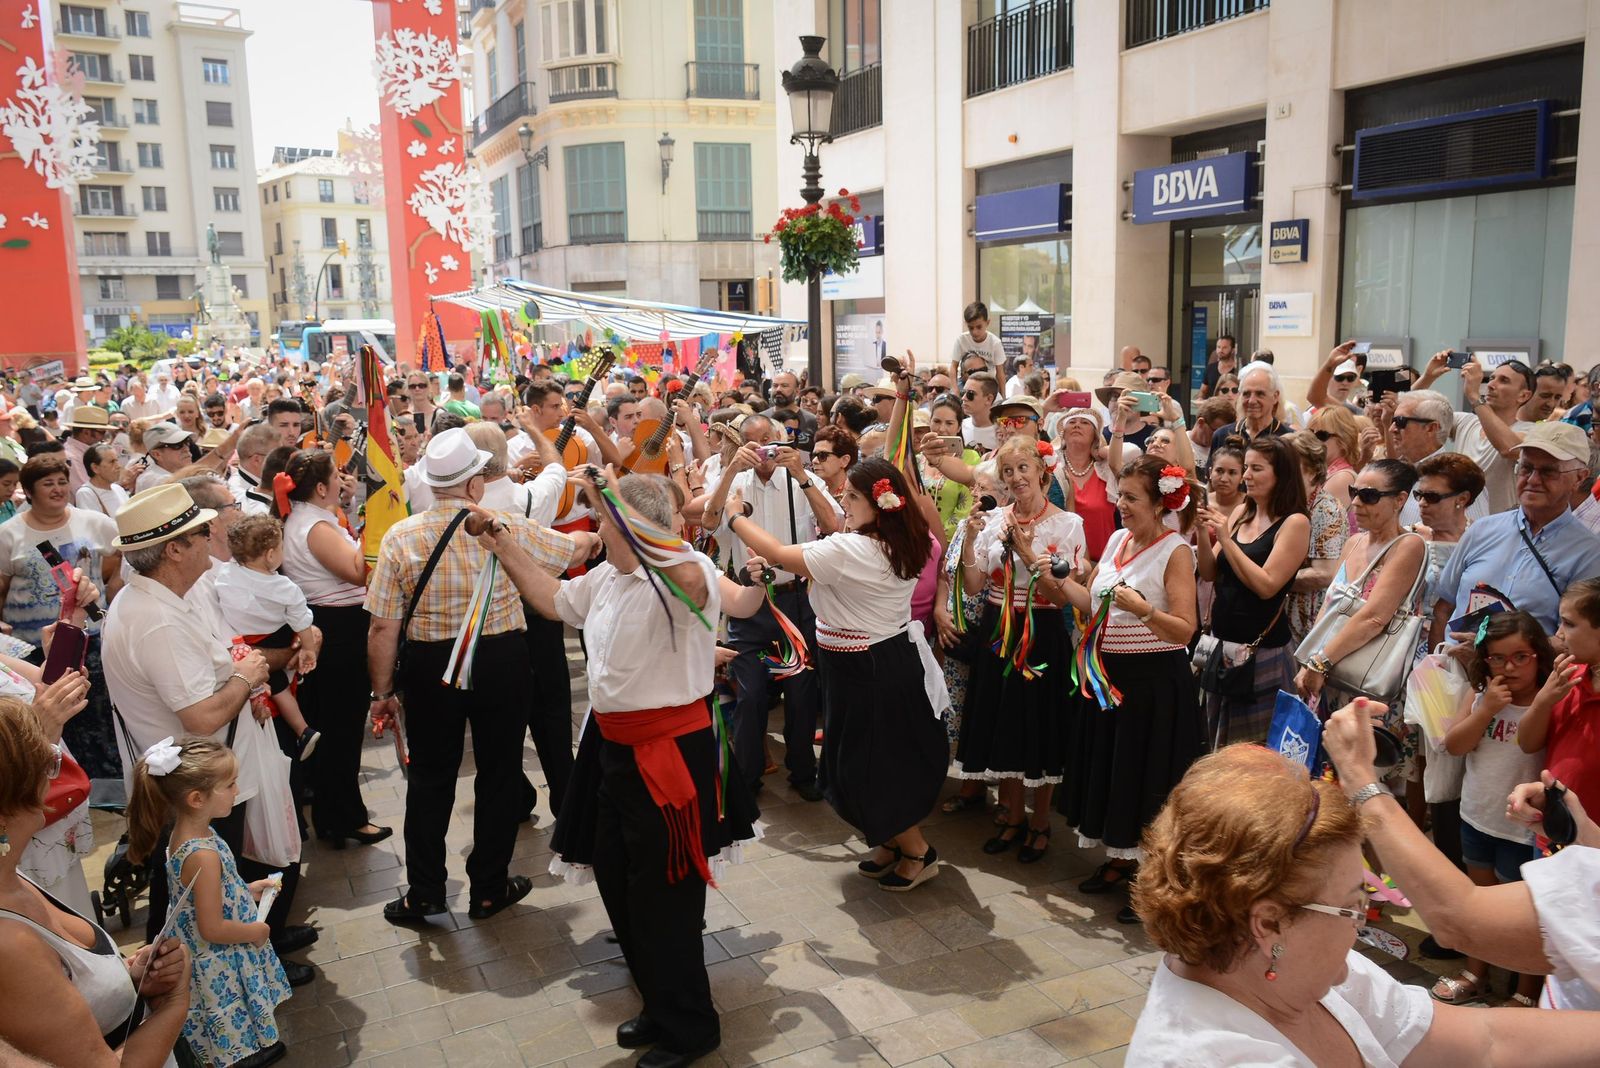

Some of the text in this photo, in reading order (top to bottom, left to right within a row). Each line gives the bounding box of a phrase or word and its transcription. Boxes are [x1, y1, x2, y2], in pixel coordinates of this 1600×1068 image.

[1153, 166, 1218, 206] BBVA
[1273, 227, 1300, 240] BBVA
[1269, 301, 1287, 310] BBVA
[1368, 353, 1396, 364] BBVA
